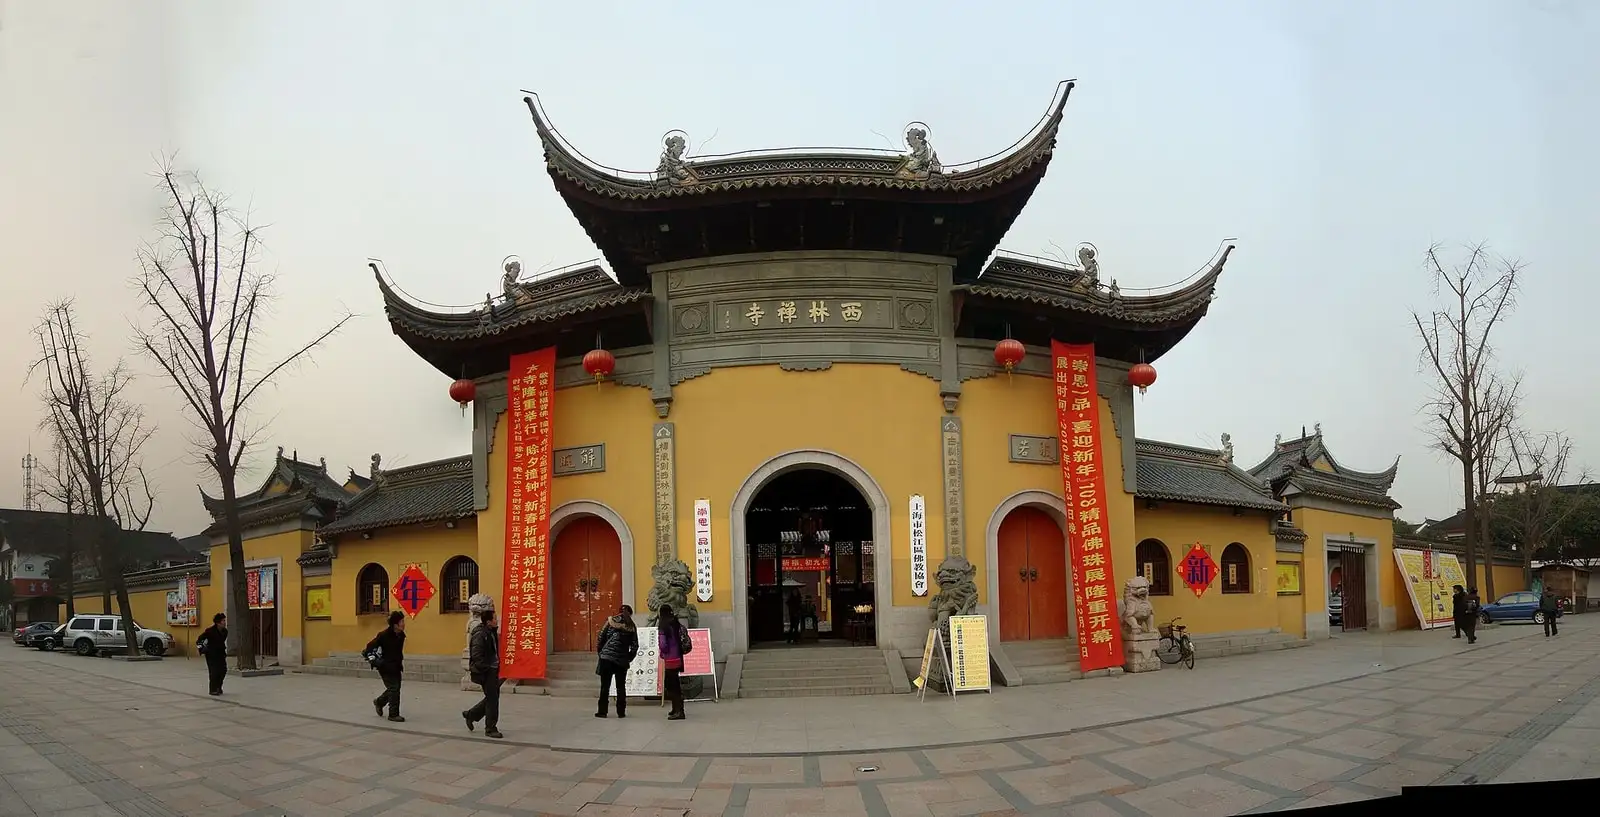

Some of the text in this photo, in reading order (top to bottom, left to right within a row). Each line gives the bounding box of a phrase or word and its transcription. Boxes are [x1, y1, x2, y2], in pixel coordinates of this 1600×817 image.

[745, 300, 863, 326] 西林禪寺
[1187, 555, 1210, 585] 新
[400, 576, 427, 609] 年
